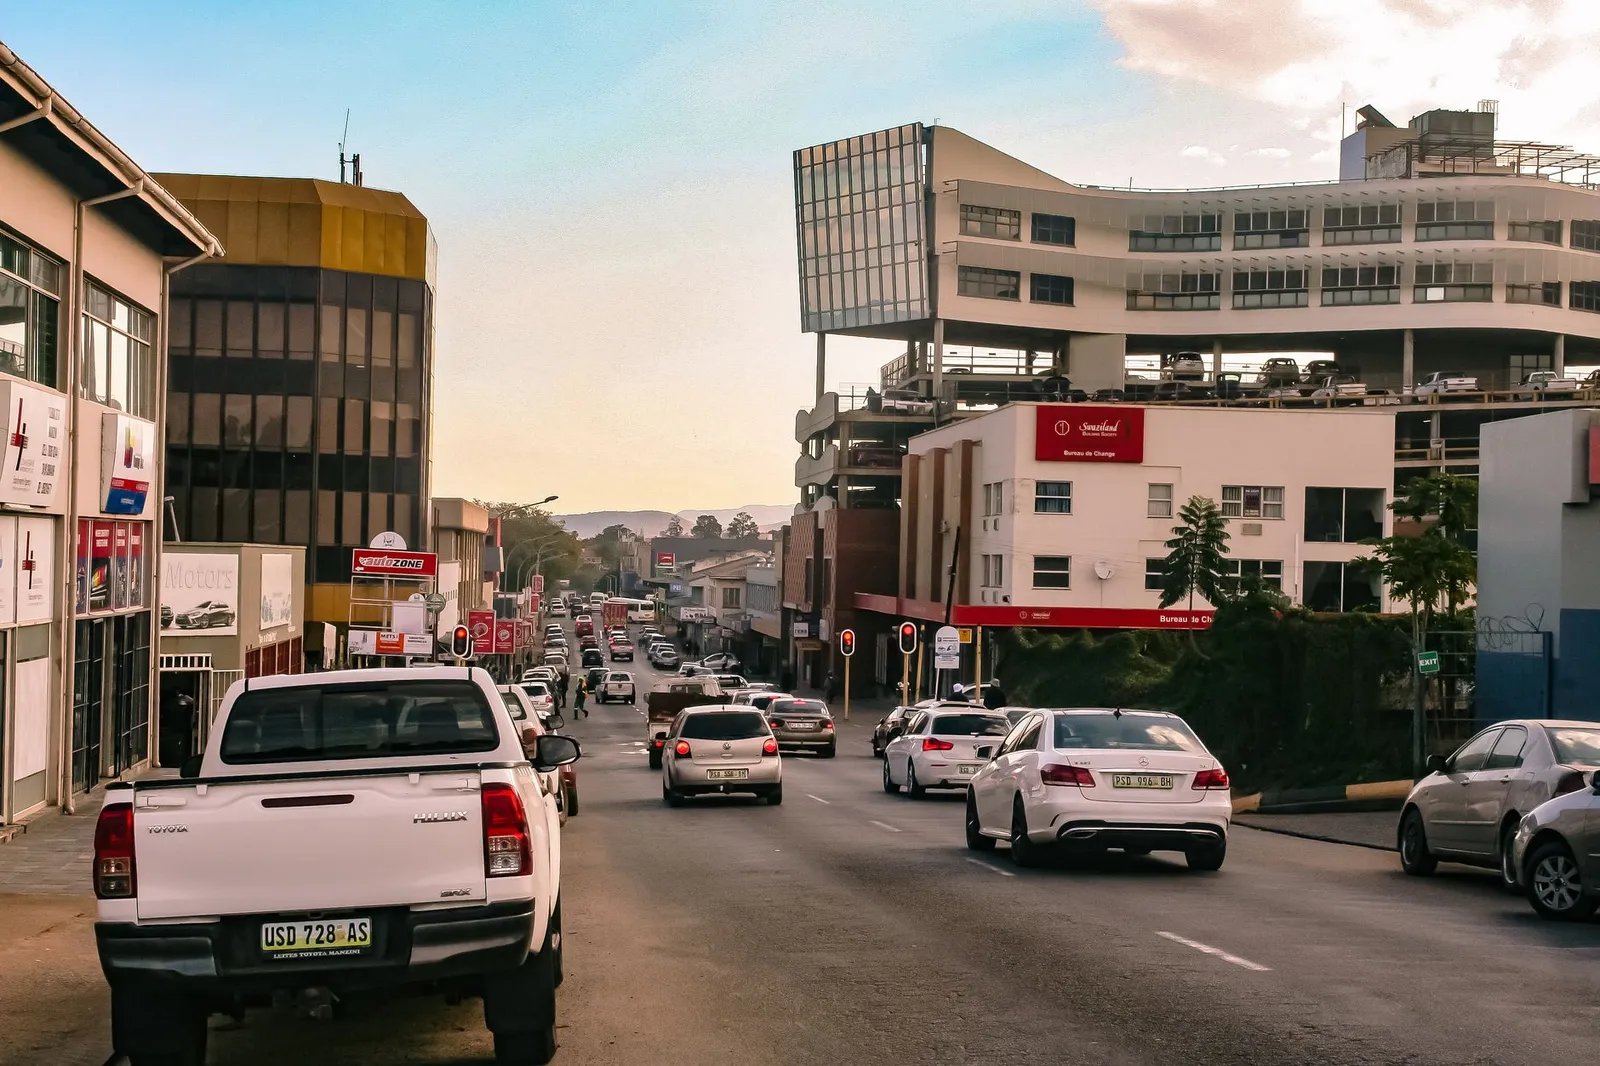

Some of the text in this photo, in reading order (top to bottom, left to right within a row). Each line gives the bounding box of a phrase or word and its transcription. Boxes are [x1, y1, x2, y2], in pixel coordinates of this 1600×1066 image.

[1078, 419, 1121, 433] Swaziland
[1094, 450, 1115, 458] Change
[164, 562, 234, 589] Motors
[1160, 615, 1188, 623] Bureau
[1201, 615, 1214, 623] Ch
[1419, 658, 1437, 666] EXIT
[1115, 776, 1171, 787] PSD 996 BH
[413, 811, 469, 824] HILUX
[147, 824, 188, 834] TOYOTA
[265, 921, 368, 947] USD 728 AS
[328, 948, 361, 957] MANZINI
